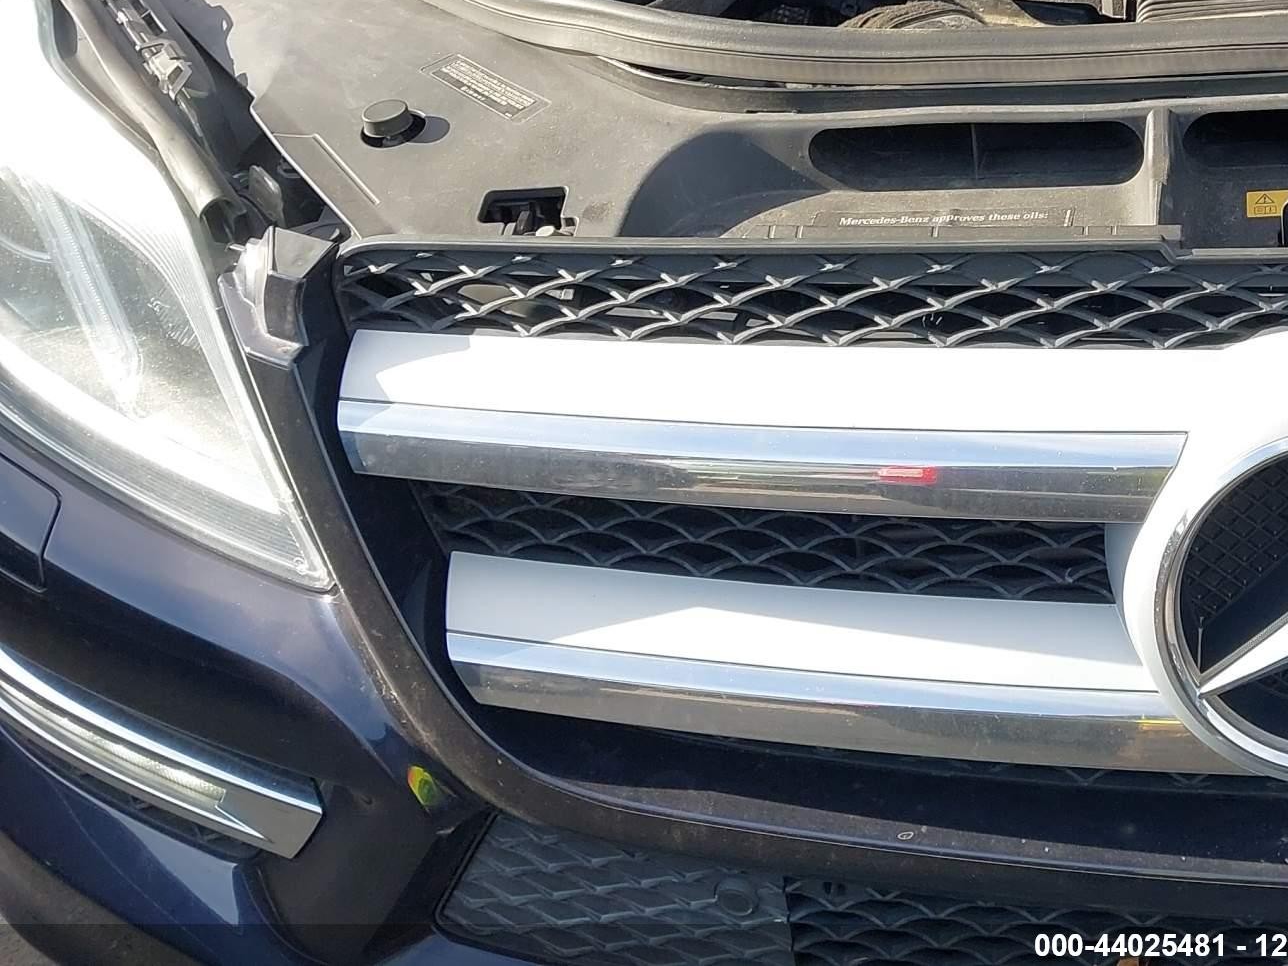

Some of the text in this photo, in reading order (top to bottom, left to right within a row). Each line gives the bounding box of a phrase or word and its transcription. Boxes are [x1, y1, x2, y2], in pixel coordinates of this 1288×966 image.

[839, 210, 1049, 226] Mercedes-Benz approves these oils:
